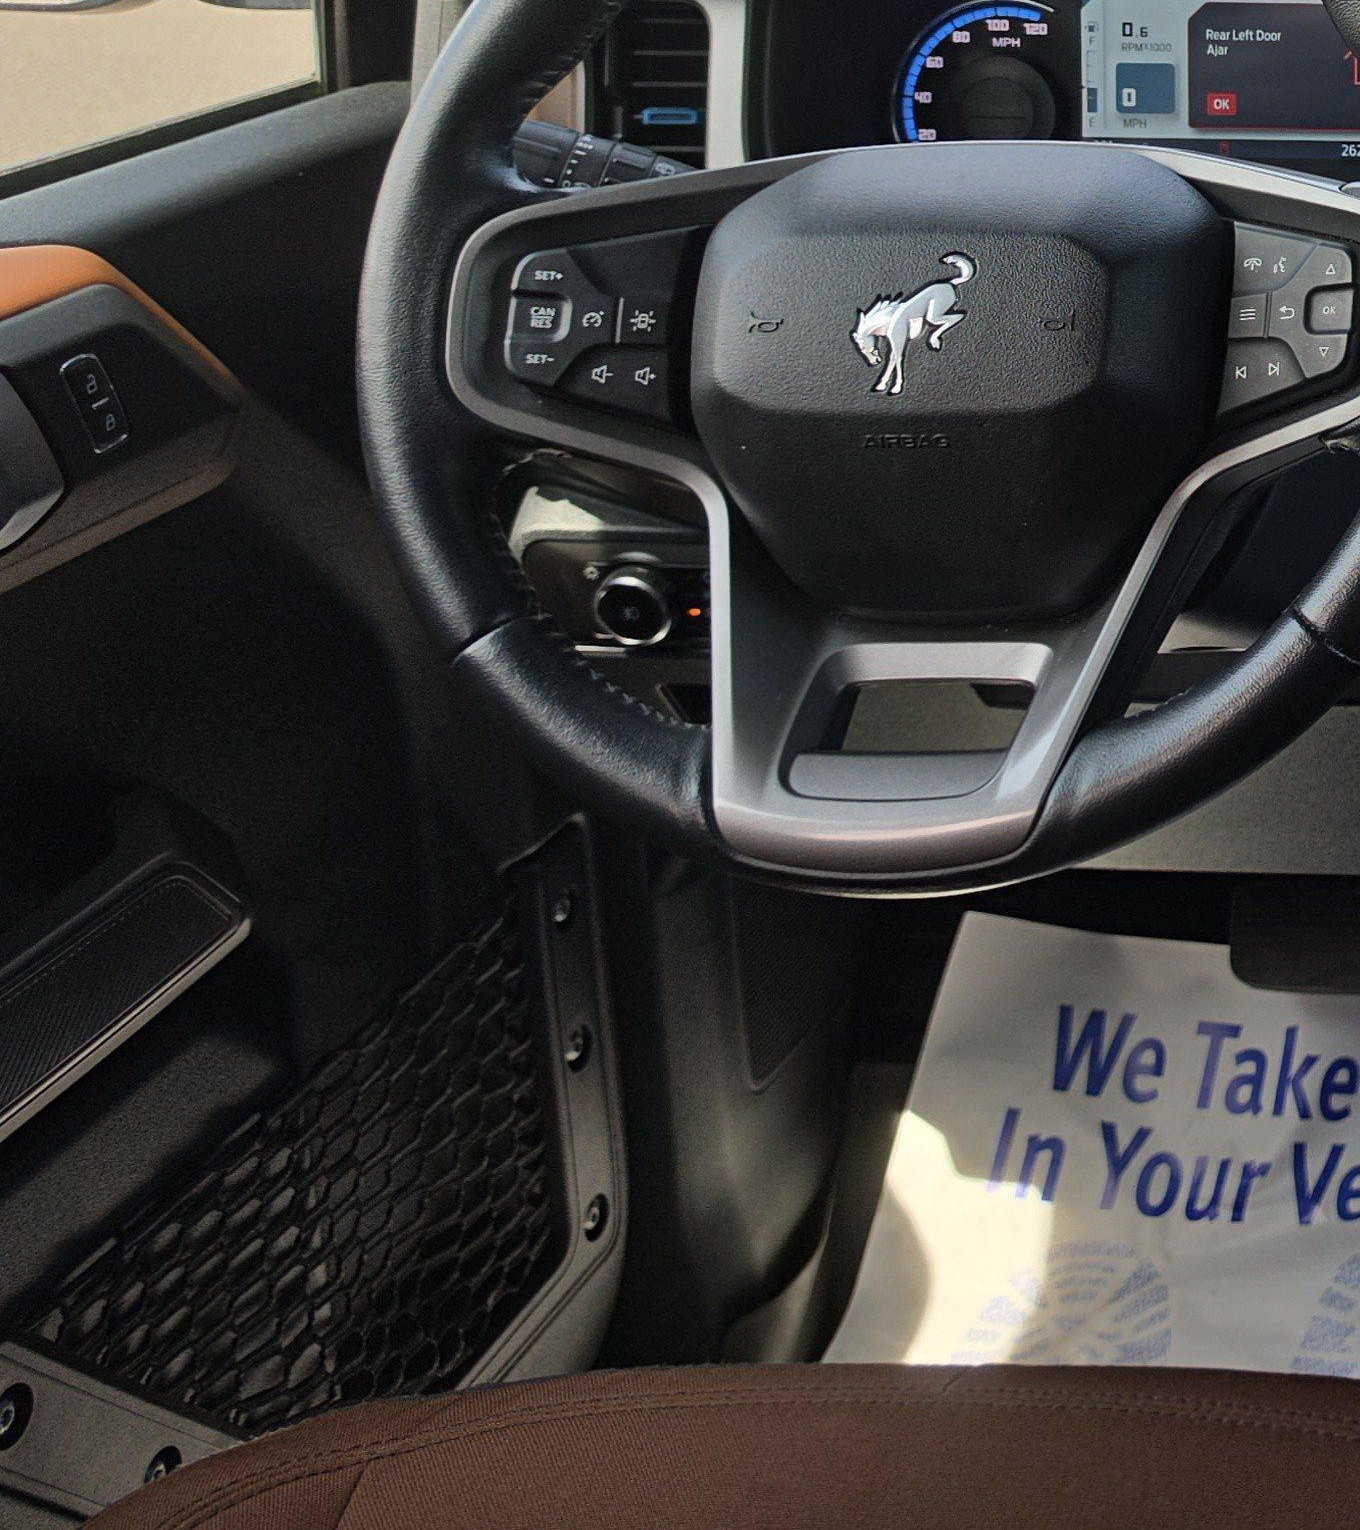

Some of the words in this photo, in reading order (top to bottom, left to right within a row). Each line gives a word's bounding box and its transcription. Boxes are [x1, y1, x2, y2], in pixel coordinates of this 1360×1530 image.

[986, 19, 1010, 31] 100
[1205, 29, 1230, 42] Rear
[1232, 29, 1254, 42] Left
[1256, 29, 1282, 42] Door
[992, 37, 1021, 48] MPH
[1206, 44, 1229, 56] Ajar
[914, 91, 932, 104] 40
[1213, 99, 1230, 110] OK
[1122, 119, 1148, 129] MPH
[530, 307, 556, 318] CAN
[1322, 305, 1336, 316] OK
[530, 318, 553, 329] RES
[863, 434, 951, 450] AIRBAG
[1051, 1003, 1167, 1105] We
[1195, 1021, 1360, 1123] Take
[988, 1107, 1068, 1204] In
[1098, 1120, 1272, 1224] Your
